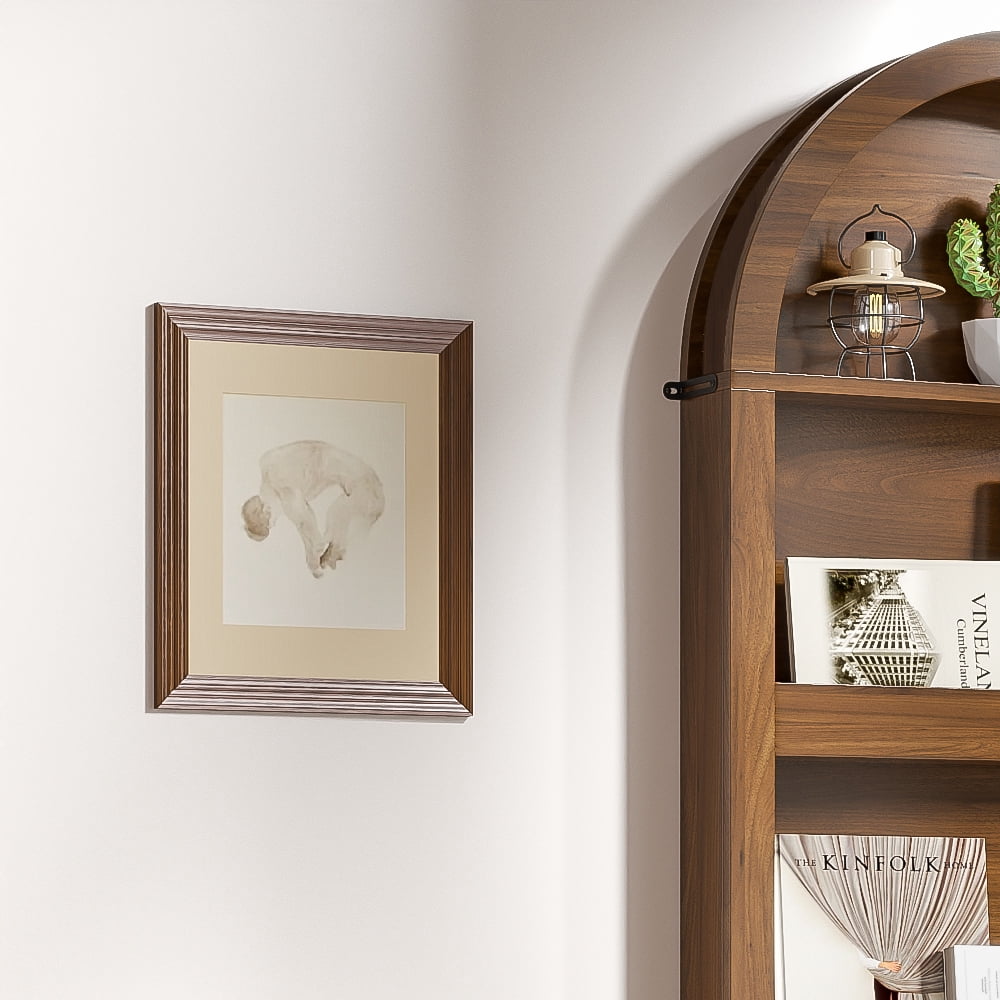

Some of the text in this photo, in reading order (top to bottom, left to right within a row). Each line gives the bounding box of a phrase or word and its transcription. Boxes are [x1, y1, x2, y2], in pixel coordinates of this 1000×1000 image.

[956, 618, 971, 689] Cumberland
[795, 858, 817, 867] THE
[822, 854, 941, 872] KINFOLK
